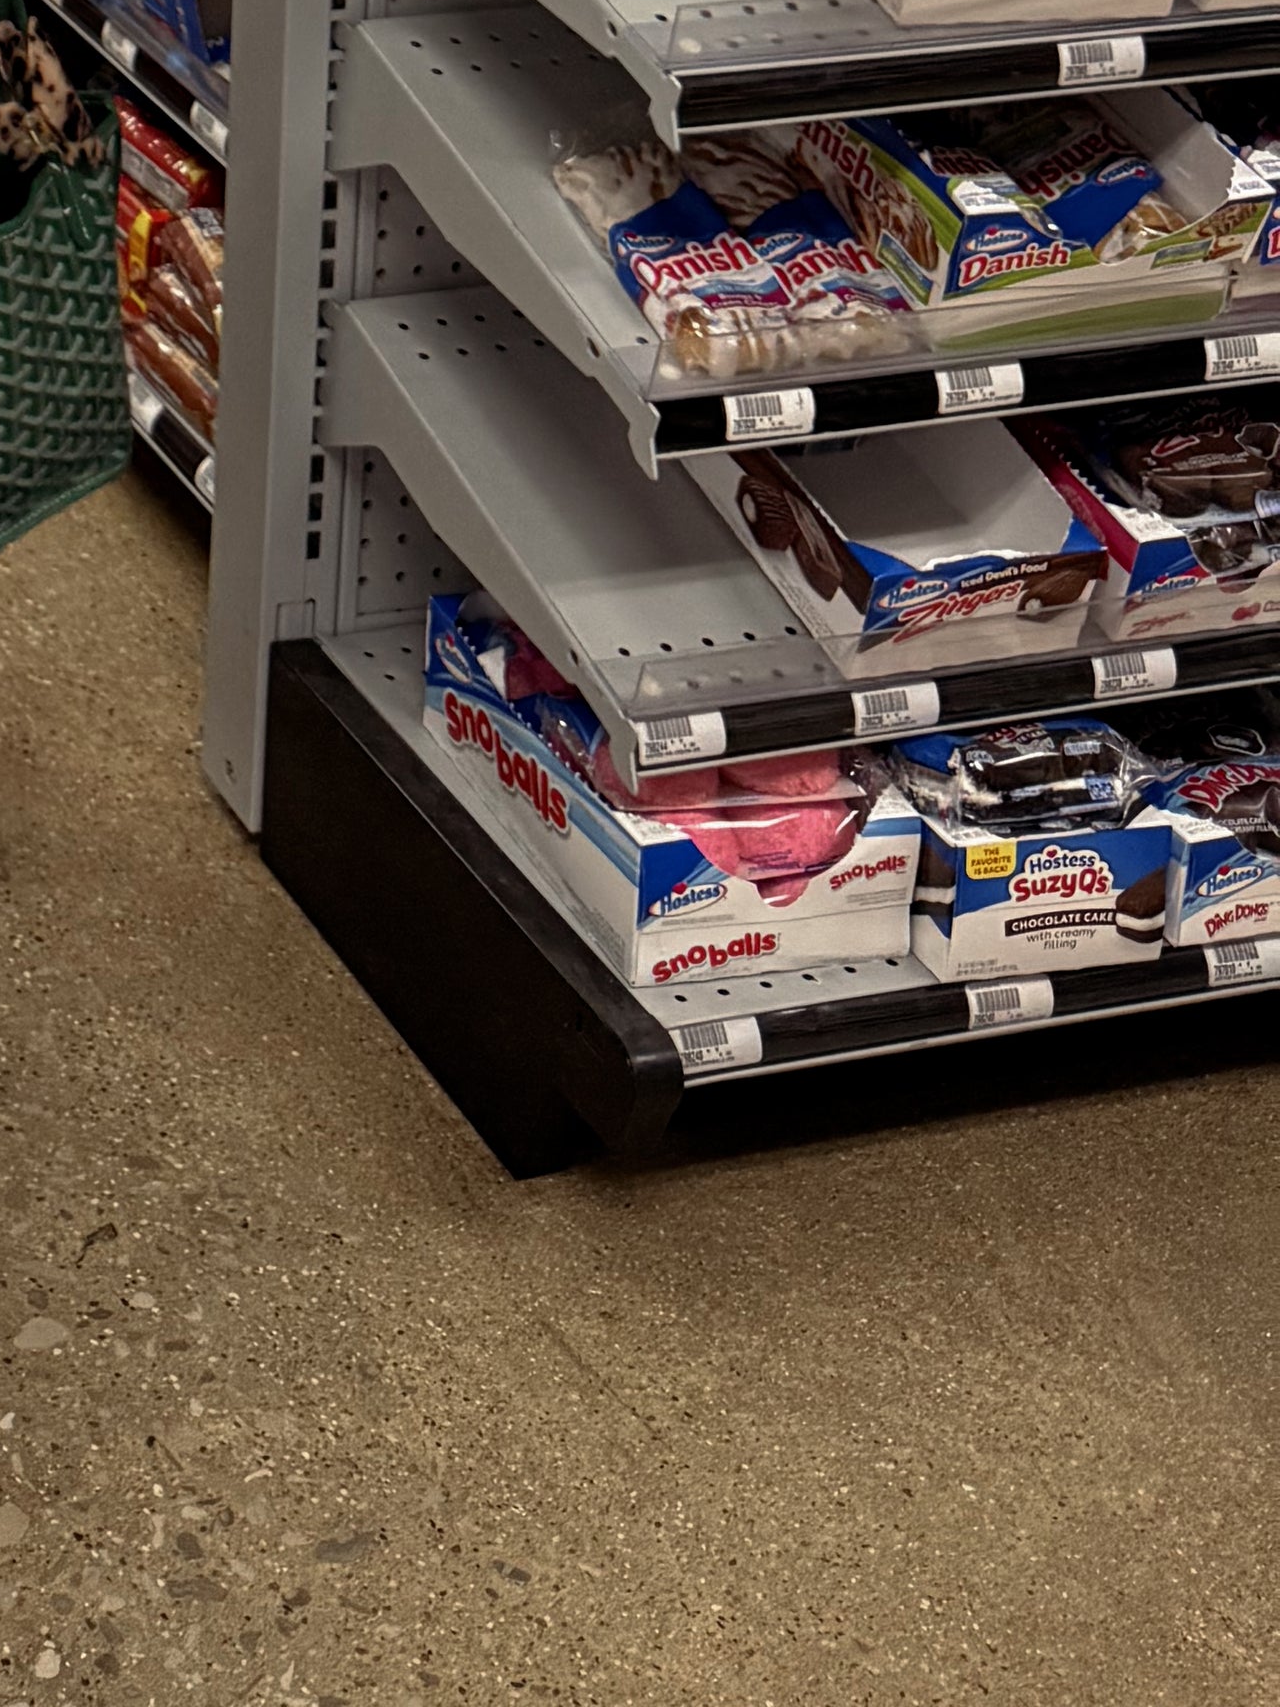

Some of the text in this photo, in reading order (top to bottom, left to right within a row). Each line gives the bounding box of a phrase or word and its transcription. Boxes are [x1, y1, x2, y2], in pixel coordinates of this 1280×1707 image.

[632, 235, 756, 291] Danish
[776, 241, 882, 296] Danish
[959, 241, 1071, 287] Danish
[960, 560, 1049, 589] Iced Devil's Food
[893, 578, 1022, 645] Zingers
[444, 692, 569, 831] snoballs
[970, 854, 1013, 867] FAVORITE
[973, 863, 1009, 876] IS BACK!
[983, 847, 1001, 857] THE
[1029, 852, 1097, 874] Hostess
[829, 854, 907, 891] snoballs
[1013, 866, 1111, 902] SuzyQ's
[659, 880, 727, 918] Hostess
[1011, 909, 1114, 933] CHOCOLATE CAKE
[1026, 927, 1097, 944] with creamy
[1204, 902, 1270, 937] DING DONGS
[651, 931, 779, 984] snoballs
[1043, 938, 1078, 950] filling
